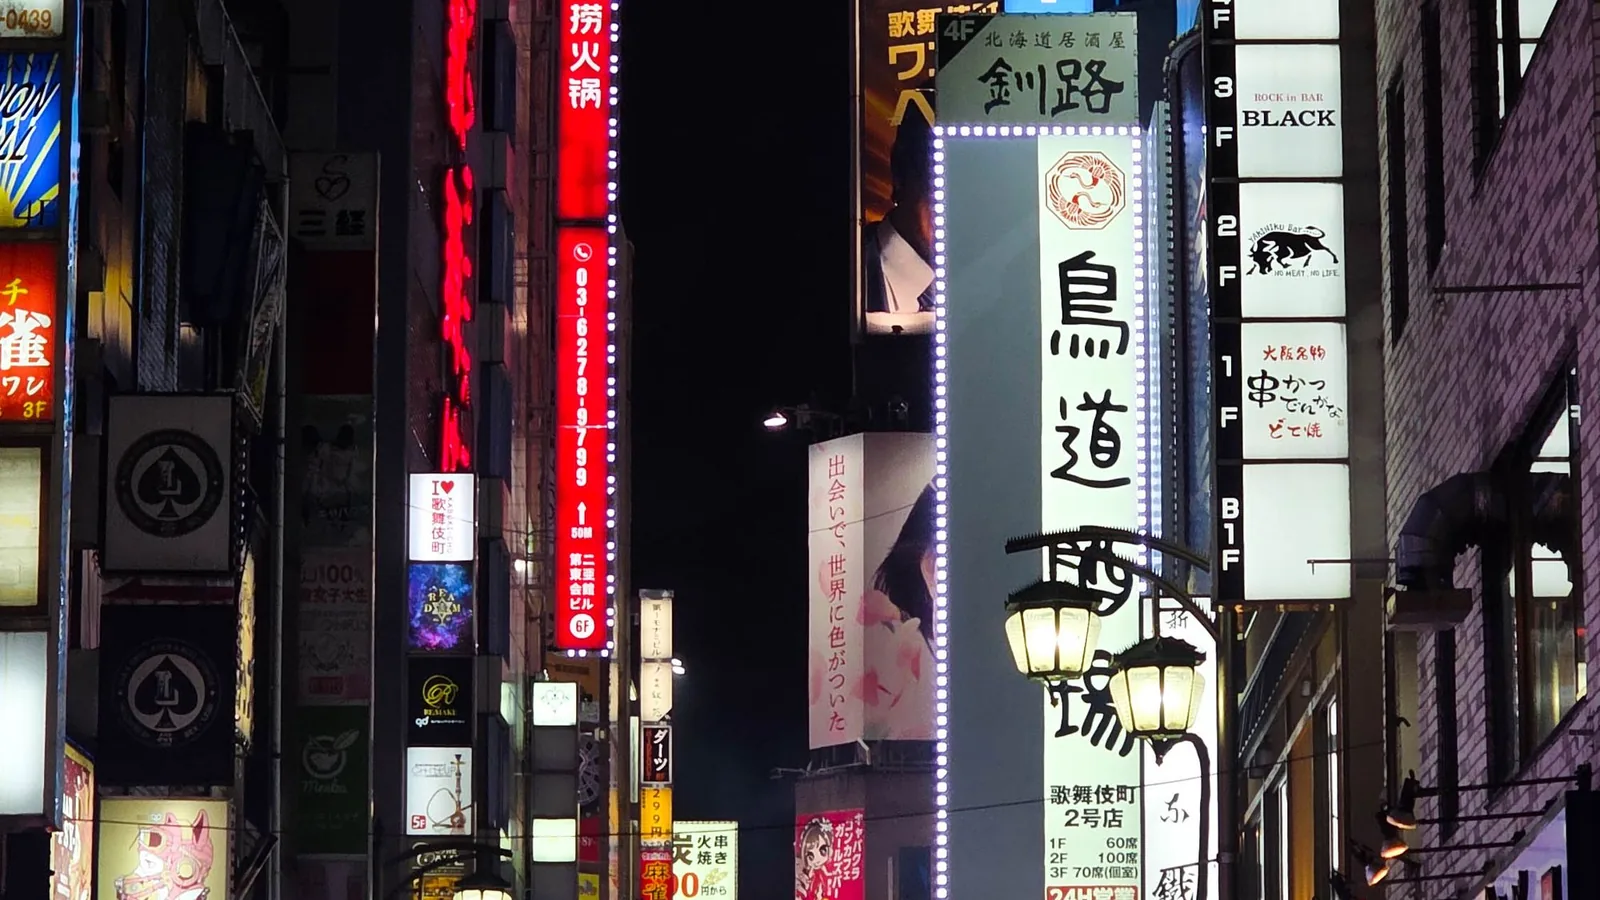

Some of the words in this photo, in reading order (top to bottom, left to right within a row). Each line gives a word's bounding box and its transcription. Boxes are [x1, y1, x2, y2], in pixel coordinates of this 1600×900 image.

[943, 19, 975, 41] 4F
[984, 29, 1126, 49] 北海道居酒屋
[568, 3, 603, 109] 捞火锅
[977, 56, 1125, 117] 釧路
[1254, 93, 1283, 102] ROCK
[1286, 93, 1297, 102] in
[1301, 93, 1324, 102] BAR
[1213, 76, 1234, 148] 3F
[1242, 110, 1336, 127] BLACK
[1217, 214, 1237, 287] 2F
[1263, 345, 1326, 361] 大阪名物
[575, 267, 588, 487] 03-6278-9799
[1220, 355, 1239, 428] 1F
[22, 400, 47, 419] 3F
[431, 497, 446, 555] 歌舞伎町
[1222, 497, 1241, 572] B1F
[569, 597, 595, 610] ビル
[827, 454, 847, 732] 出会いで、世界に色がついた
[575, 619, 590, 633] 6F
[653, 729, 669, 771] ダーツ
[1050, 784, 1136, 805] 歌舞伎町
[1064, 808, 1124, 829] 2号店
[1050, 838, 1067, 849] 1F
[1106, 837, 1138, 850] 60席
[1050, 852, 1068, 864] 2F
[1098, 852, 1138, 864] 100席
[1050, 867, 1068, 879] 3F
